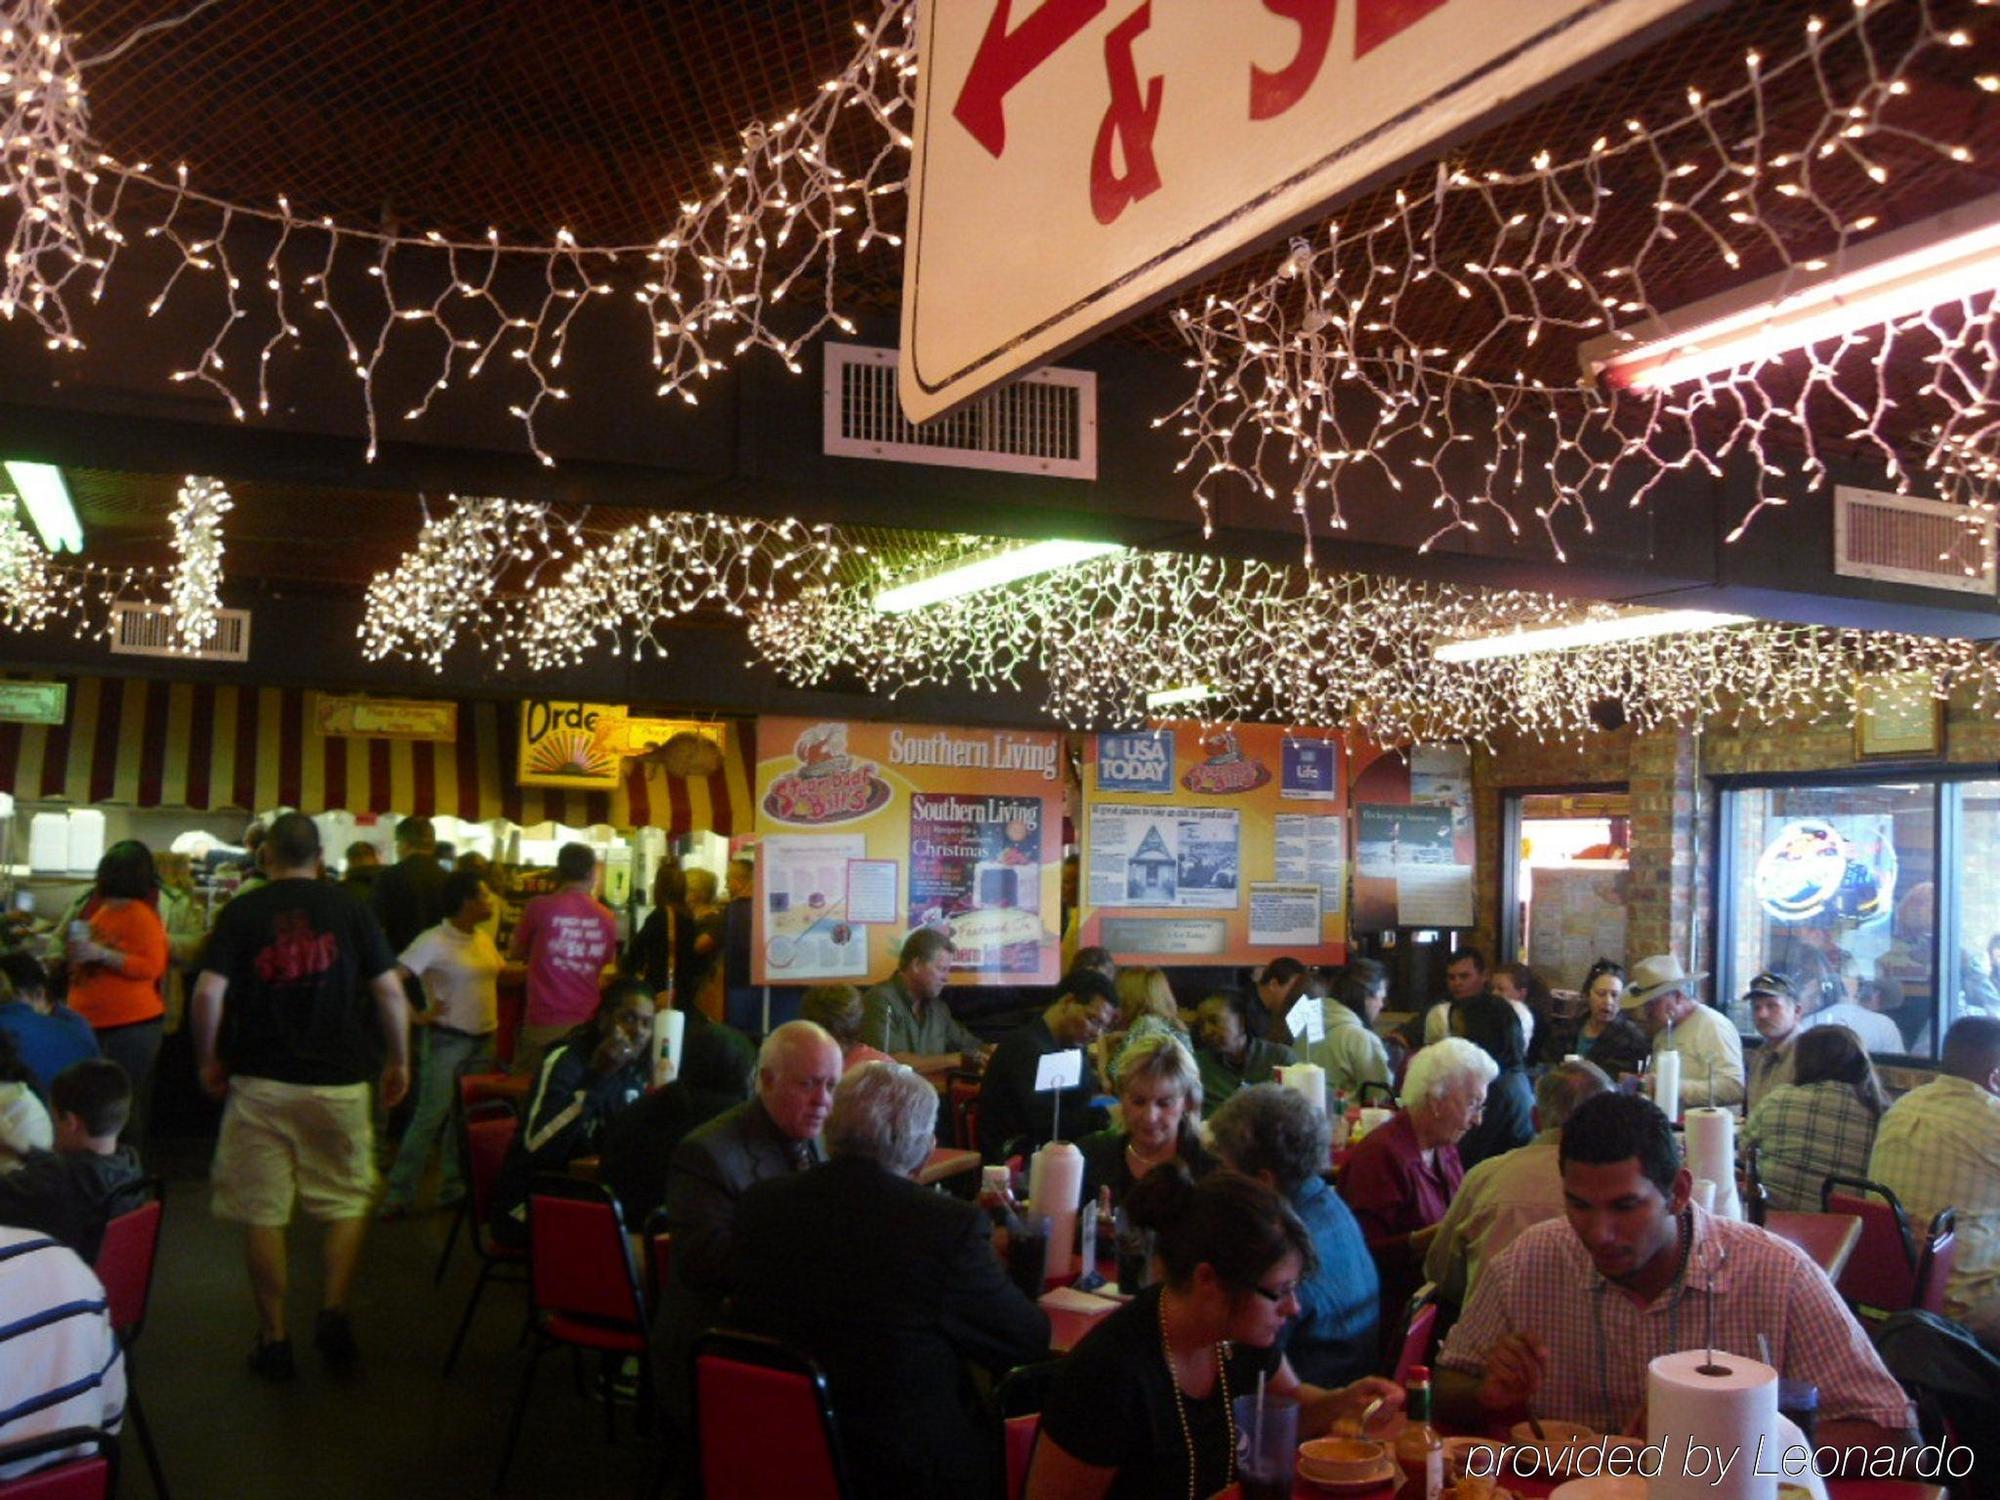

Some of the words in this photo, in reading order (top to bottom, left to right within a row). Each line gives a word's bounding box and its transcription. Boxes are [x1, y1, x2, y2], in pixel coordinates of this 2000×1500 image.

[528, 701, 600, 744] Orde
[889, 728, 989, 768] Southern
[992, 734, 1058, 780] Living
[1122, 739, 1166, 761] USA
[1100, 758, 1168, 782] TODAY
[913, 794, 985, 823] Southern
[988, 798, 1038, 832] Living
[913, 839, 990, 858] Christmas
